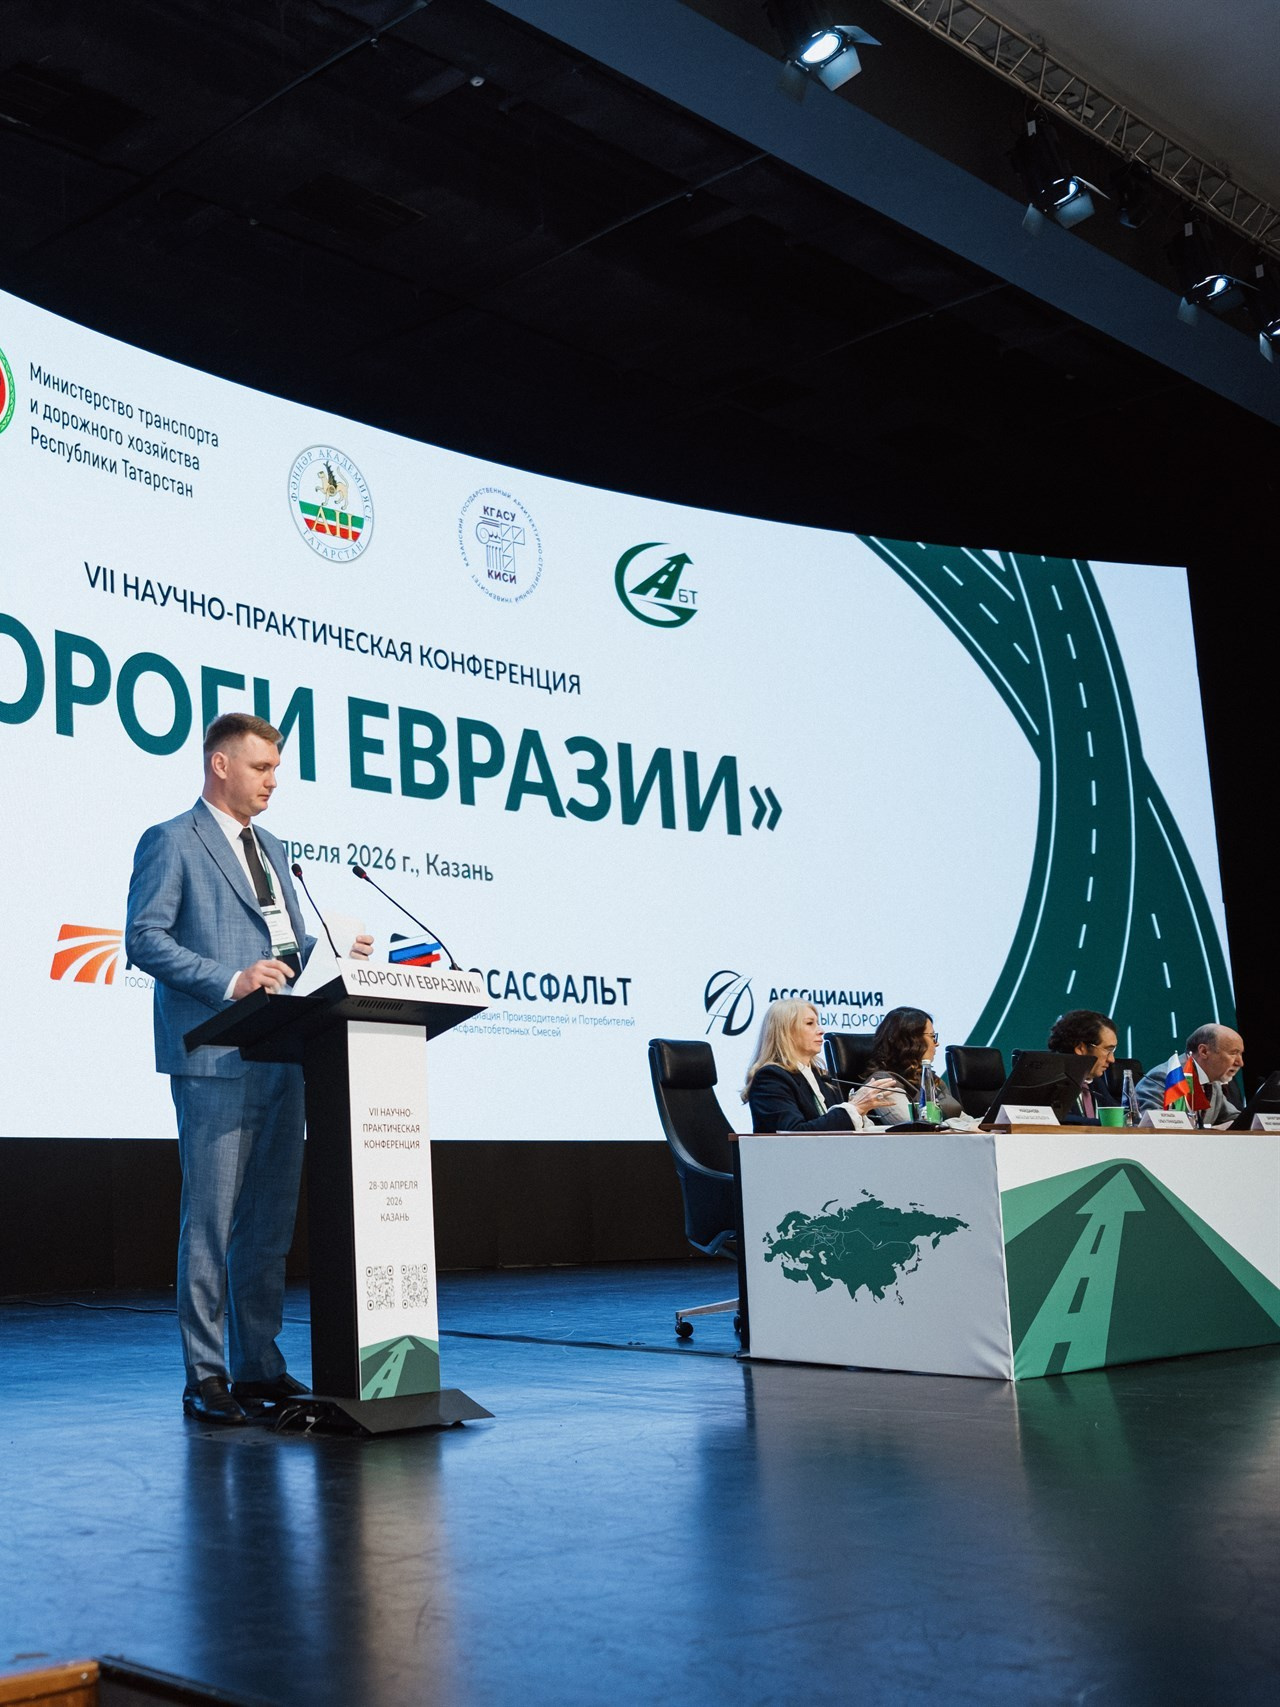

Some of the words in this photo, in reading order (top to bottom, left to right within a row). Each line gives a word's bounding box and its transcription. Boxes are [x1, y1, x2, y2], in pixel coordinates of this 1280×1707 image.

[30, 362, 133, 419] Министерство
[138, 407, 218, 447] транспорта
[30, 398, 38, 414] и
[42, 402, 122, 446] дорожного
[127, 434, 200, 471] хозяйства
[30, 427, 117, 475] Республики
[122, 458, 193, 498] Татарстан
[483, 505, 517, 522] КГАСУ
[303, 526, 364, 560] ТАТАРСТАН
[487, 568, 517, 585] КИСИ
[84, 561, 115, 595] VII
[123, 572, 412, 665] НАУЧНО-ПРАКТИЧЕСКАЯ
[419, 645, 581, 695] КОНФЕРЕНЦИЯ
[347, 695, 783, 837] ЕВРАЗИИ»
[346, 843, 396, 871] 2026
[425, 853, 494, 882] Казань
[350, 969, 415, 988] «ДОРОГИ
[416, 975, 481, 995] ЕВРАЗИИ»
[502, 1010, 569, 1025] Производителей
[578, 1014, 635, 1027] Потребителей
[531, 1027, 561, 1038] Смесей
[368, 1108, 379, 1117] VII
[380, 1108, 413, 1117] НАУЧНО-
[363, 1123, 420, 1133] ПРАКТИЧЕСКАЯ
[364, 1140, 420, 1150] КОНФЕРЕНЦИЯ
[368, 1181, 389, 1190] 28-30
[389, 1180, 418, 1190] АПРЕЛЯ
[386, 1197, 403, 1206] 2026
[380, 1212, 410, 1222] КАЗАНЬ
